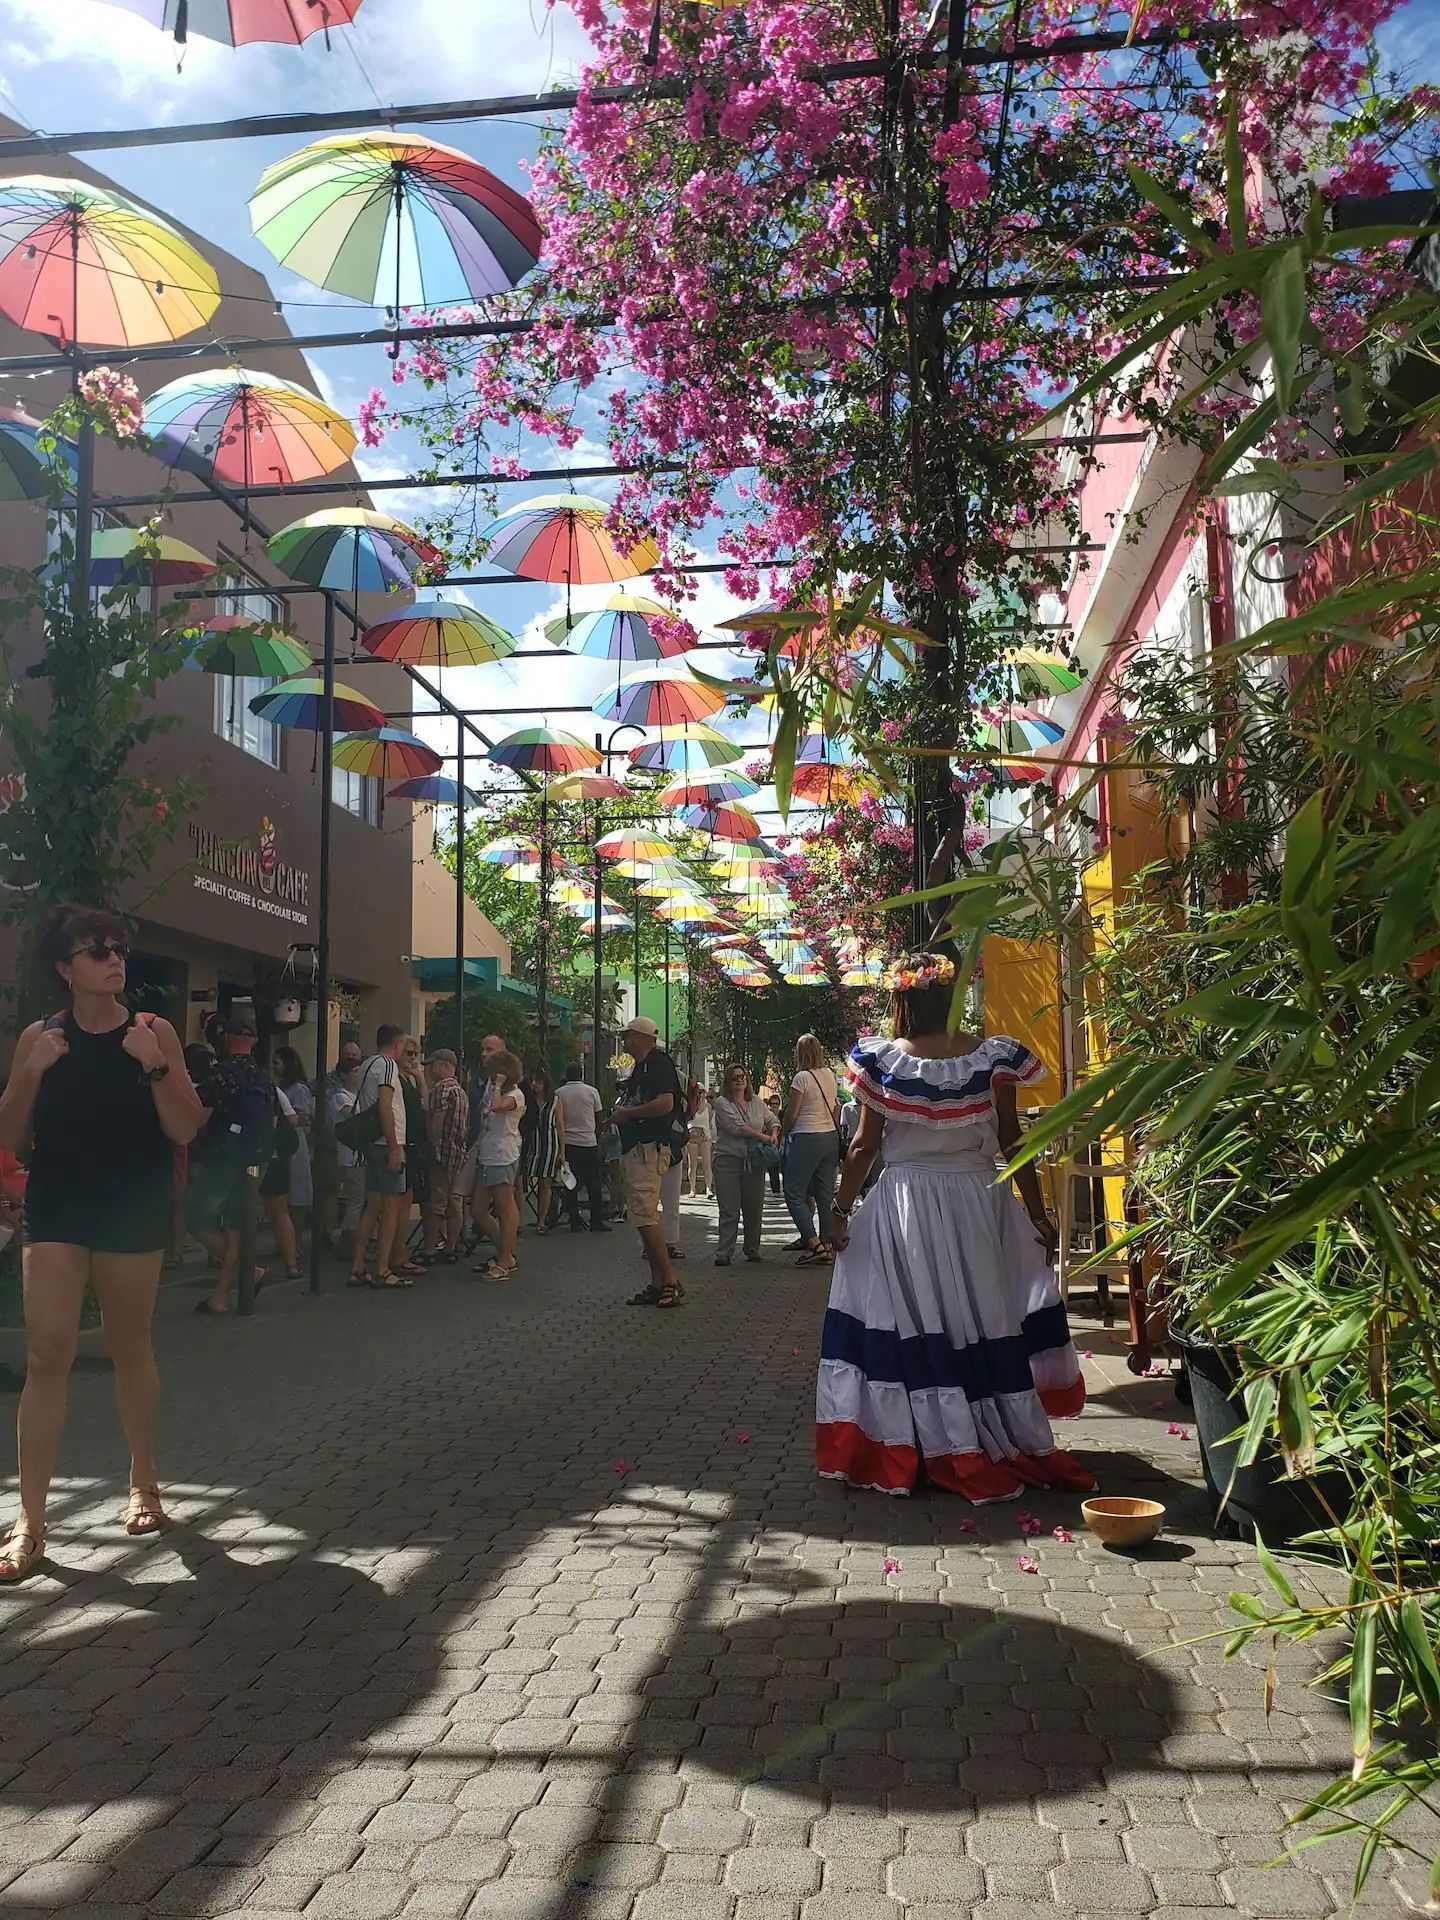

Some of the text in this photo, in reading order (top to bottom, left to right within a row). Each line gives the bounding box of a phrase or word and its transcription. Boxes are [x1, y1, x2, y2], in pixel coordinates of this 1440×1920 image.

[193, 874, 308, 925] SPECIALTY COFFEE & CHOCOLATE STORE
